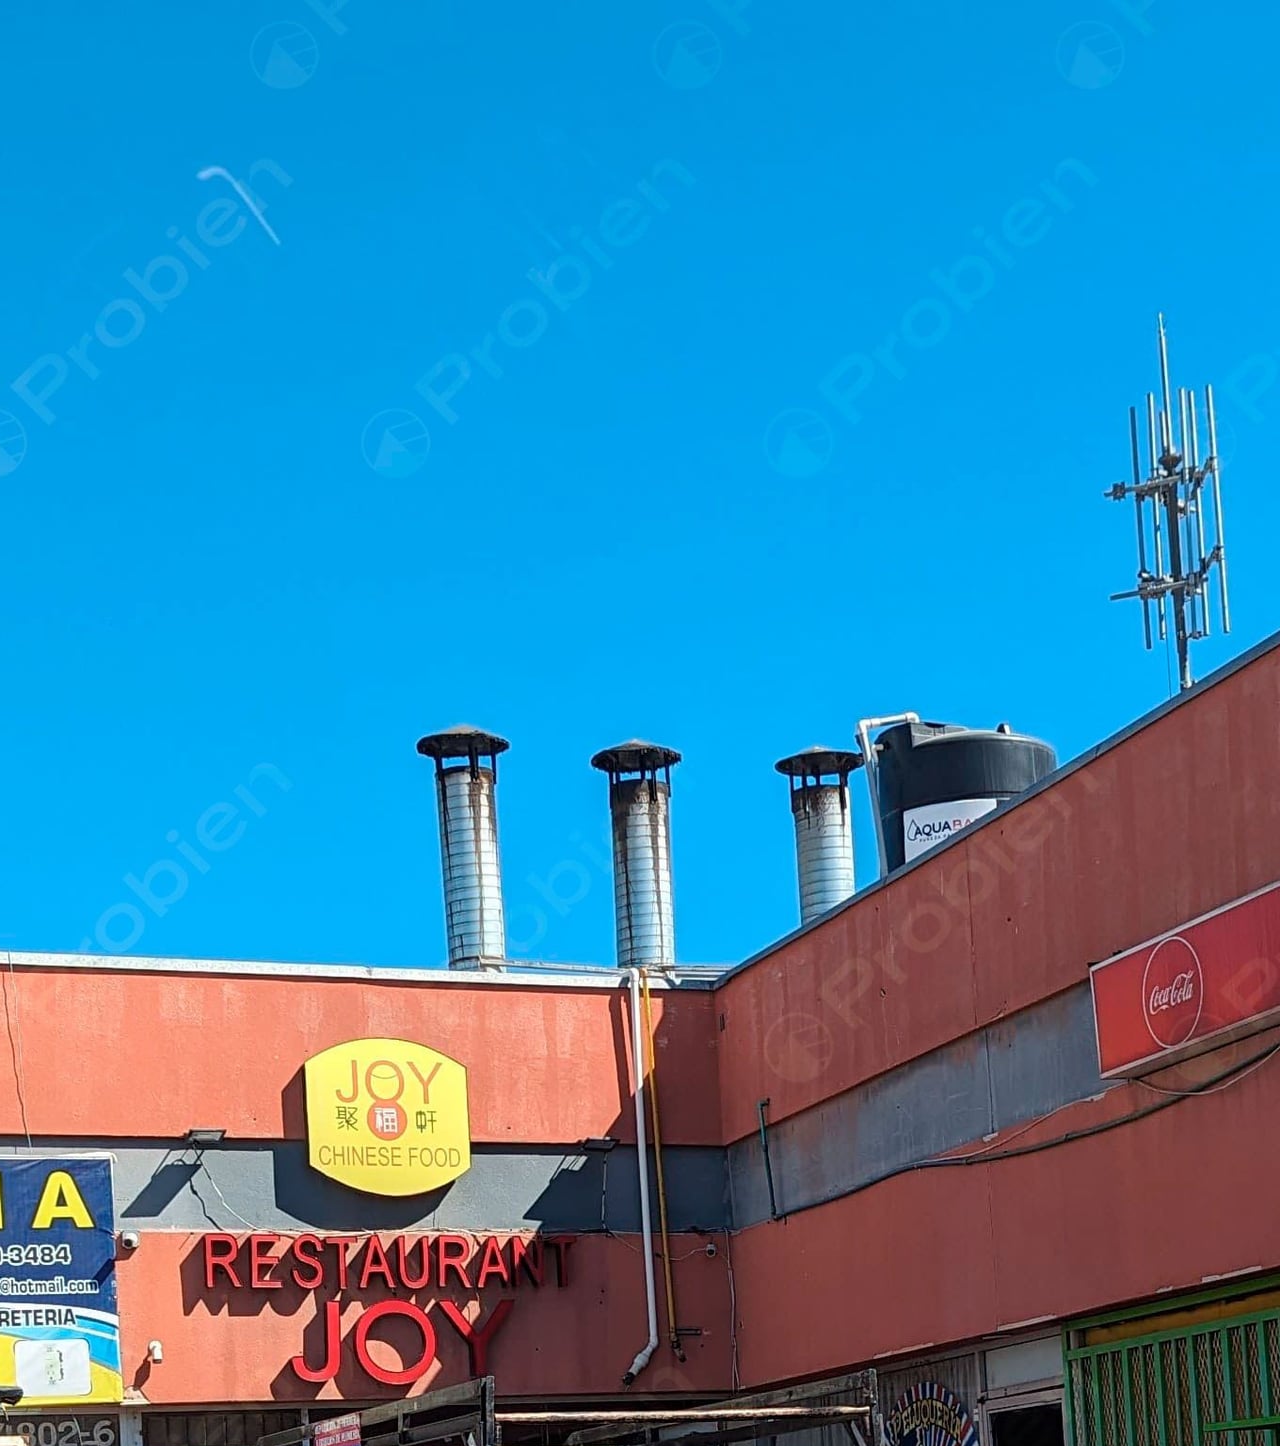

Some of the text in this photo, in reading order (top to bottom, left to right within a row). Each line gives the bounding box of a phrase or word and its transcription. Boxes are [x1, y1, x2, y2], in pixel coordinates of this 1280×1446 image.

[336, 1059, 442, 1105] JOY
[318, 1145, 461, 1169] CHINESE FOOD
[203, 1232, 577, 1291] RESTAURANT
[290, 1298, 516, 1386] JOY
